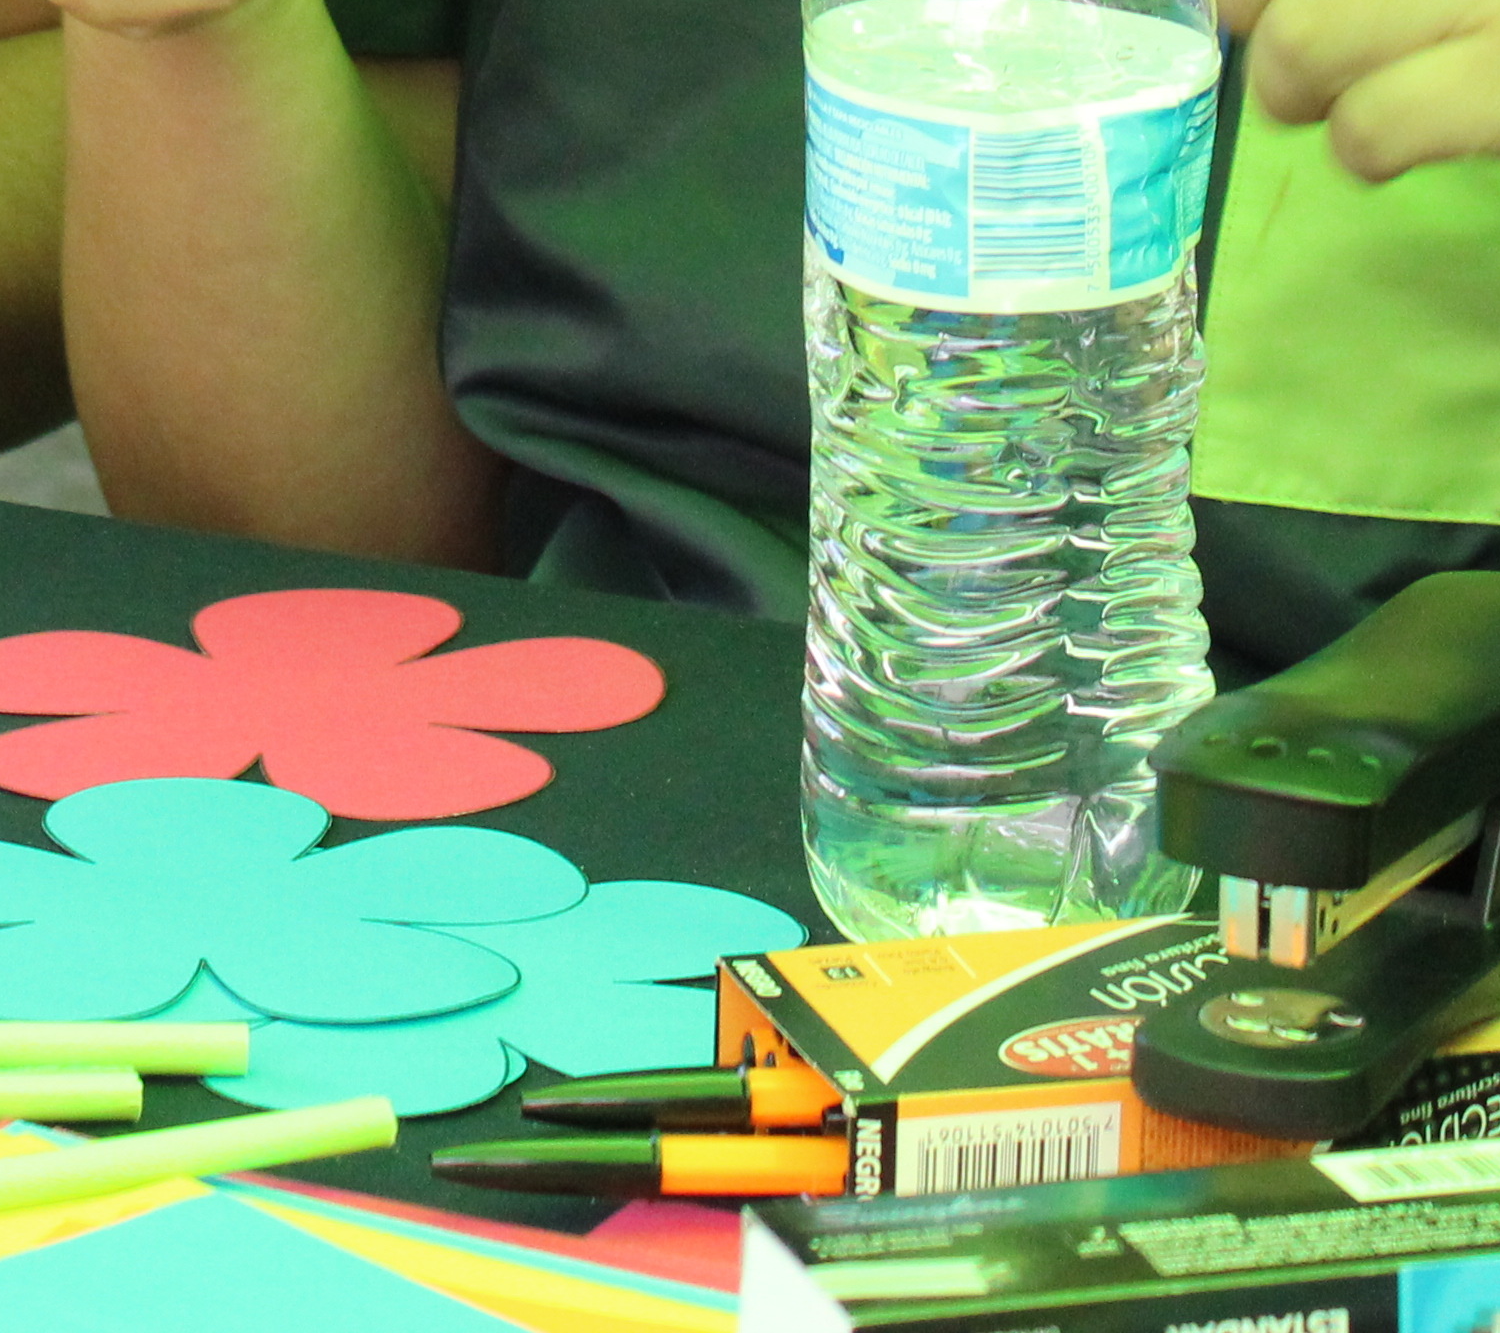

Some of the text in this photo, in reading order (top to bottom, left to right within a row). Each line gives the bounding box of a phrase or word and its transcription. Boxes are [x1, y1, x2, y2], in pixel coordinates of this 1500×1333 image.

[1012, 1021, 1136, 1063] RATIS
[923, 1120, 1002, 1145] 511061
[1014, 1115, 1093, 1137] 501014
[854, 1118, 882, 1201] NEGR
